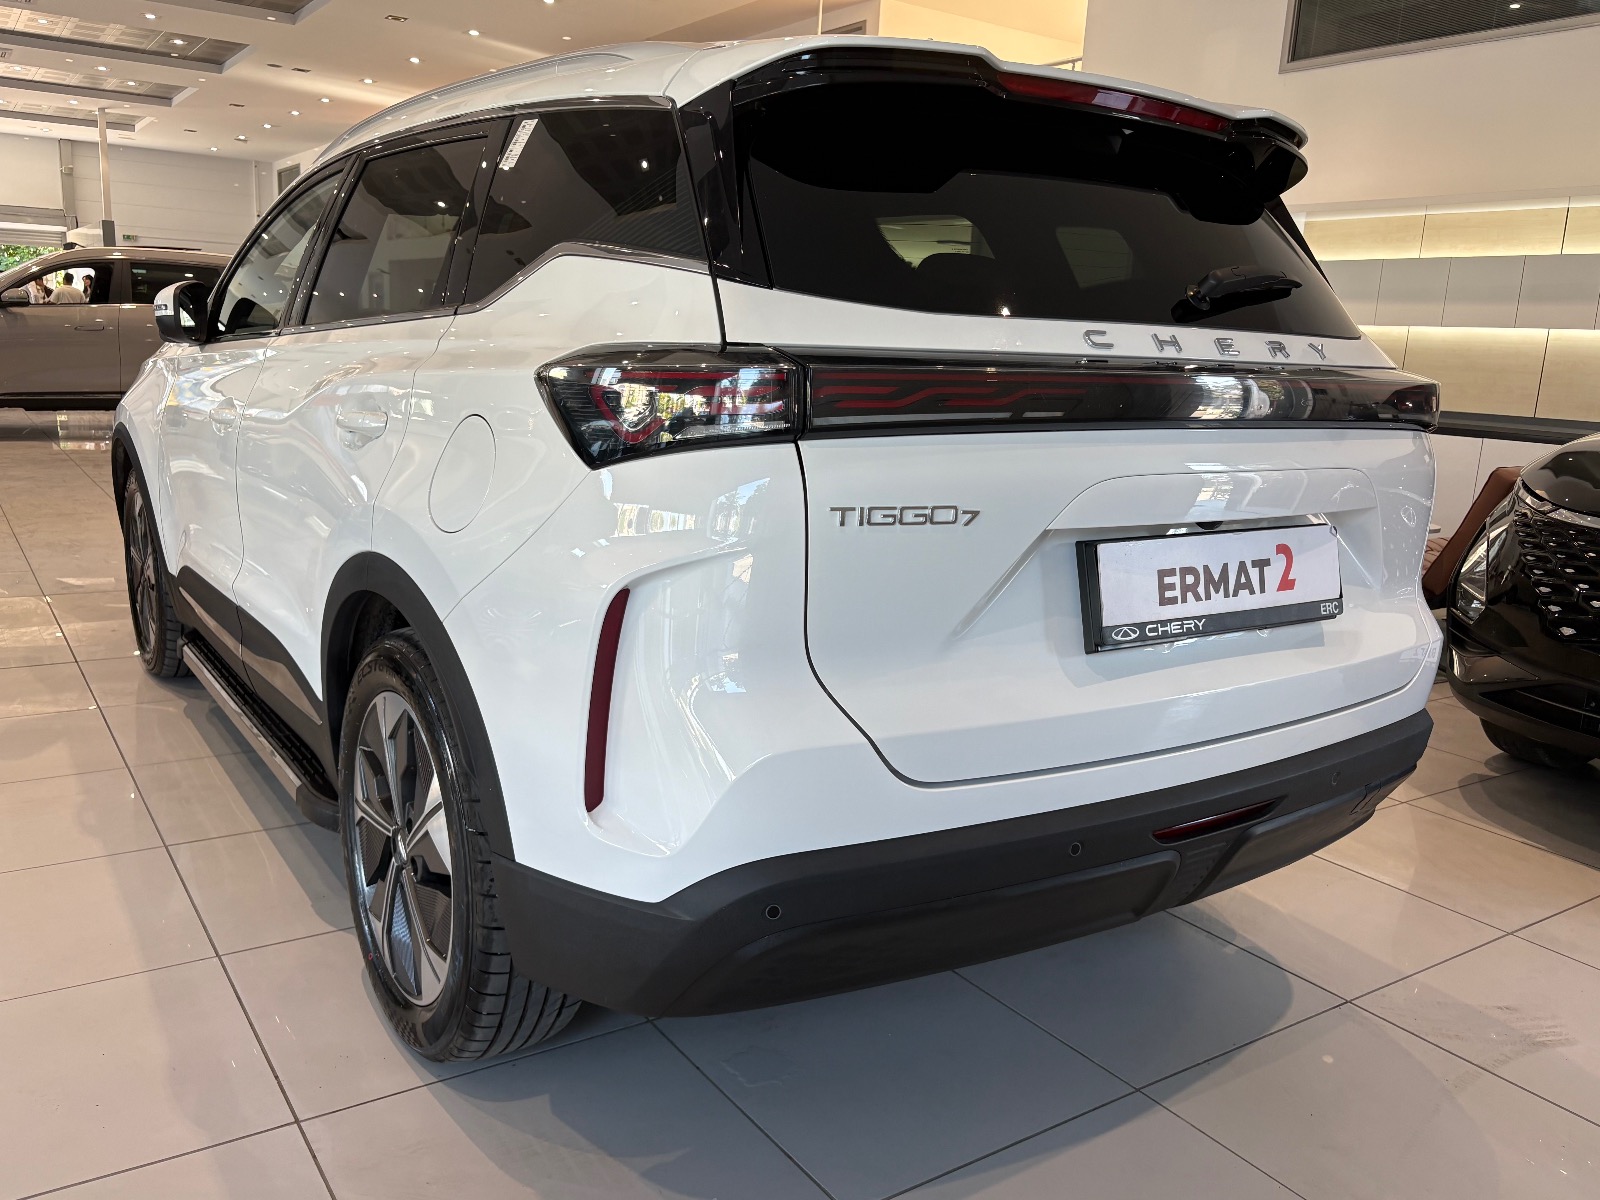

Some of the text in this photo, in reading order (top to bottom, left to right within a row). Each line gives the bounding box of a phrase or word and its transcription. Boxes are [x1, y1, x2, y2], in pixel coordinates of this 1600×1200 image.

[1083, 329, 1327, 361] CHERY
[1320, 601, 1340, 615] ERC
[1145, 618, 1206, 637] CHERY
